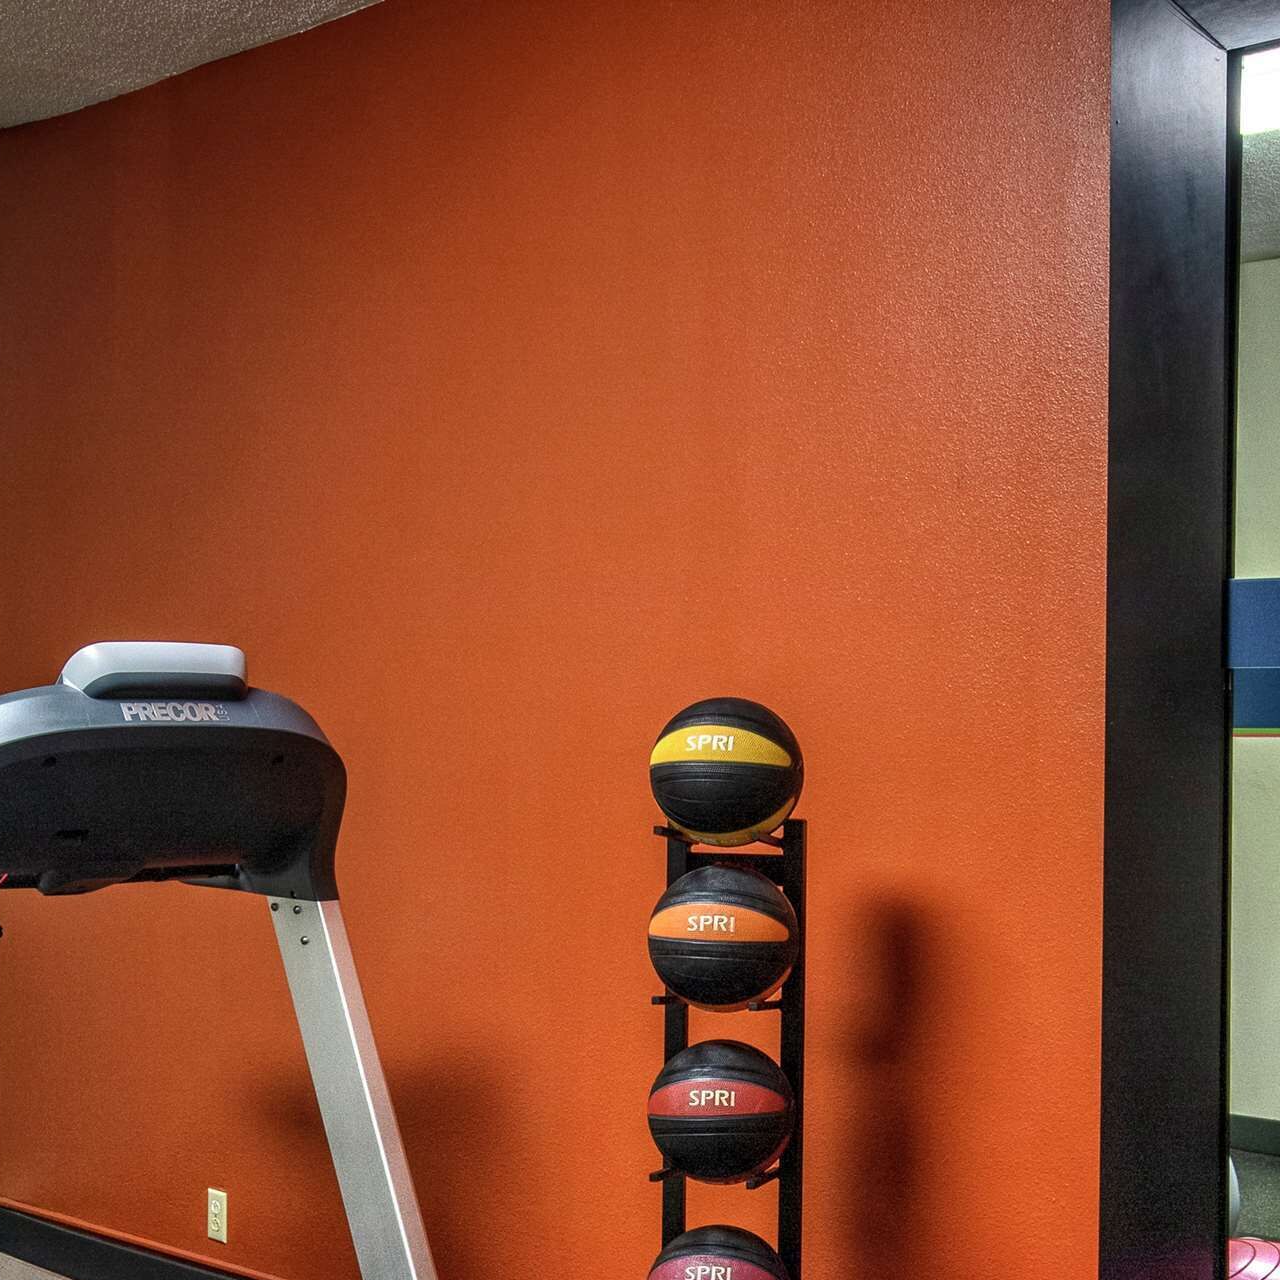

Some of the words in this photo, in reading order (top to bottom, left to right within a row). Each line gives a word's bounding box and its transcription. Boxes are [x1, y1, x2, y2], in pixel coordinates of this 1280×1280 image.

[119, 702, 219, 721] PRECOR
[685, 734, 735, 752] SPRI
[687, 914, 736, 933] SPRI
[688, 1089, 736, 1108] SPRI
